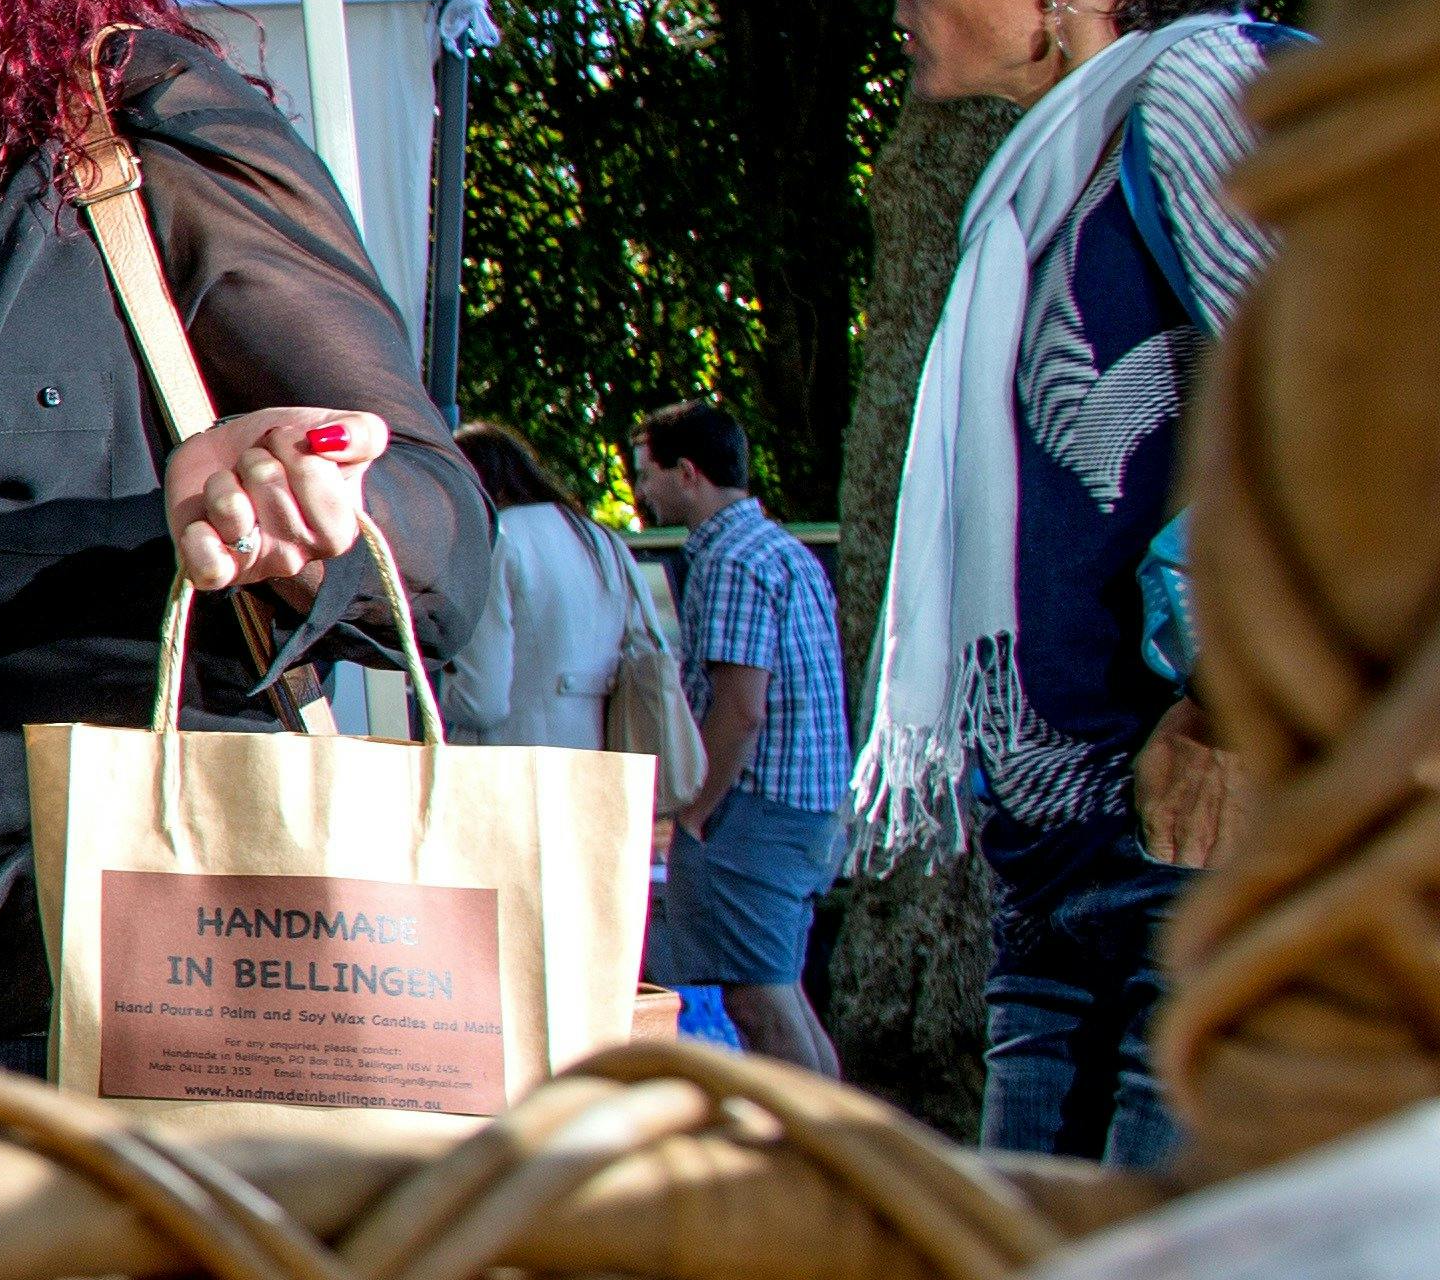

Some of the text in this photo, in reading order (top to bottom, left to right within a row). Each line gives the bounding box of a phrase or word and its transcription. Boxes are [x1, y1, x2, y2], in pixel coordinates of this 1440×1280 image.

[197, 906, 419, 946] HANDMADE
[167, 954, 453, 1000] IN BELLINGEN
[114, 1000, 153, 1015] Hand
[160, 1002, 214, 1018] Poured
[220, 1006, 256, 1021] Palm
[263, 1008, 292, 1021] and
[298, 1010, 326, 1026] Soy
[331, 1011, 365, 1026] Wax
[372, 1014, 426, 1030] Candles
[433, 1019, 458, 1031] and
[162, 1049, 218, 1061] Handmade
[220, 1051, 231, 1061] in
[288, 1055, 305, 1065] PO
[309, 1056, 329, 1066] Box
[358, 1058, 404, 1072] Bellingen
[246, 1039, 265, 1051] any
[324, 1043, 358, 1055] please
[184, 1084, 442, 1110] www.handmadeinbellingen.com.au
